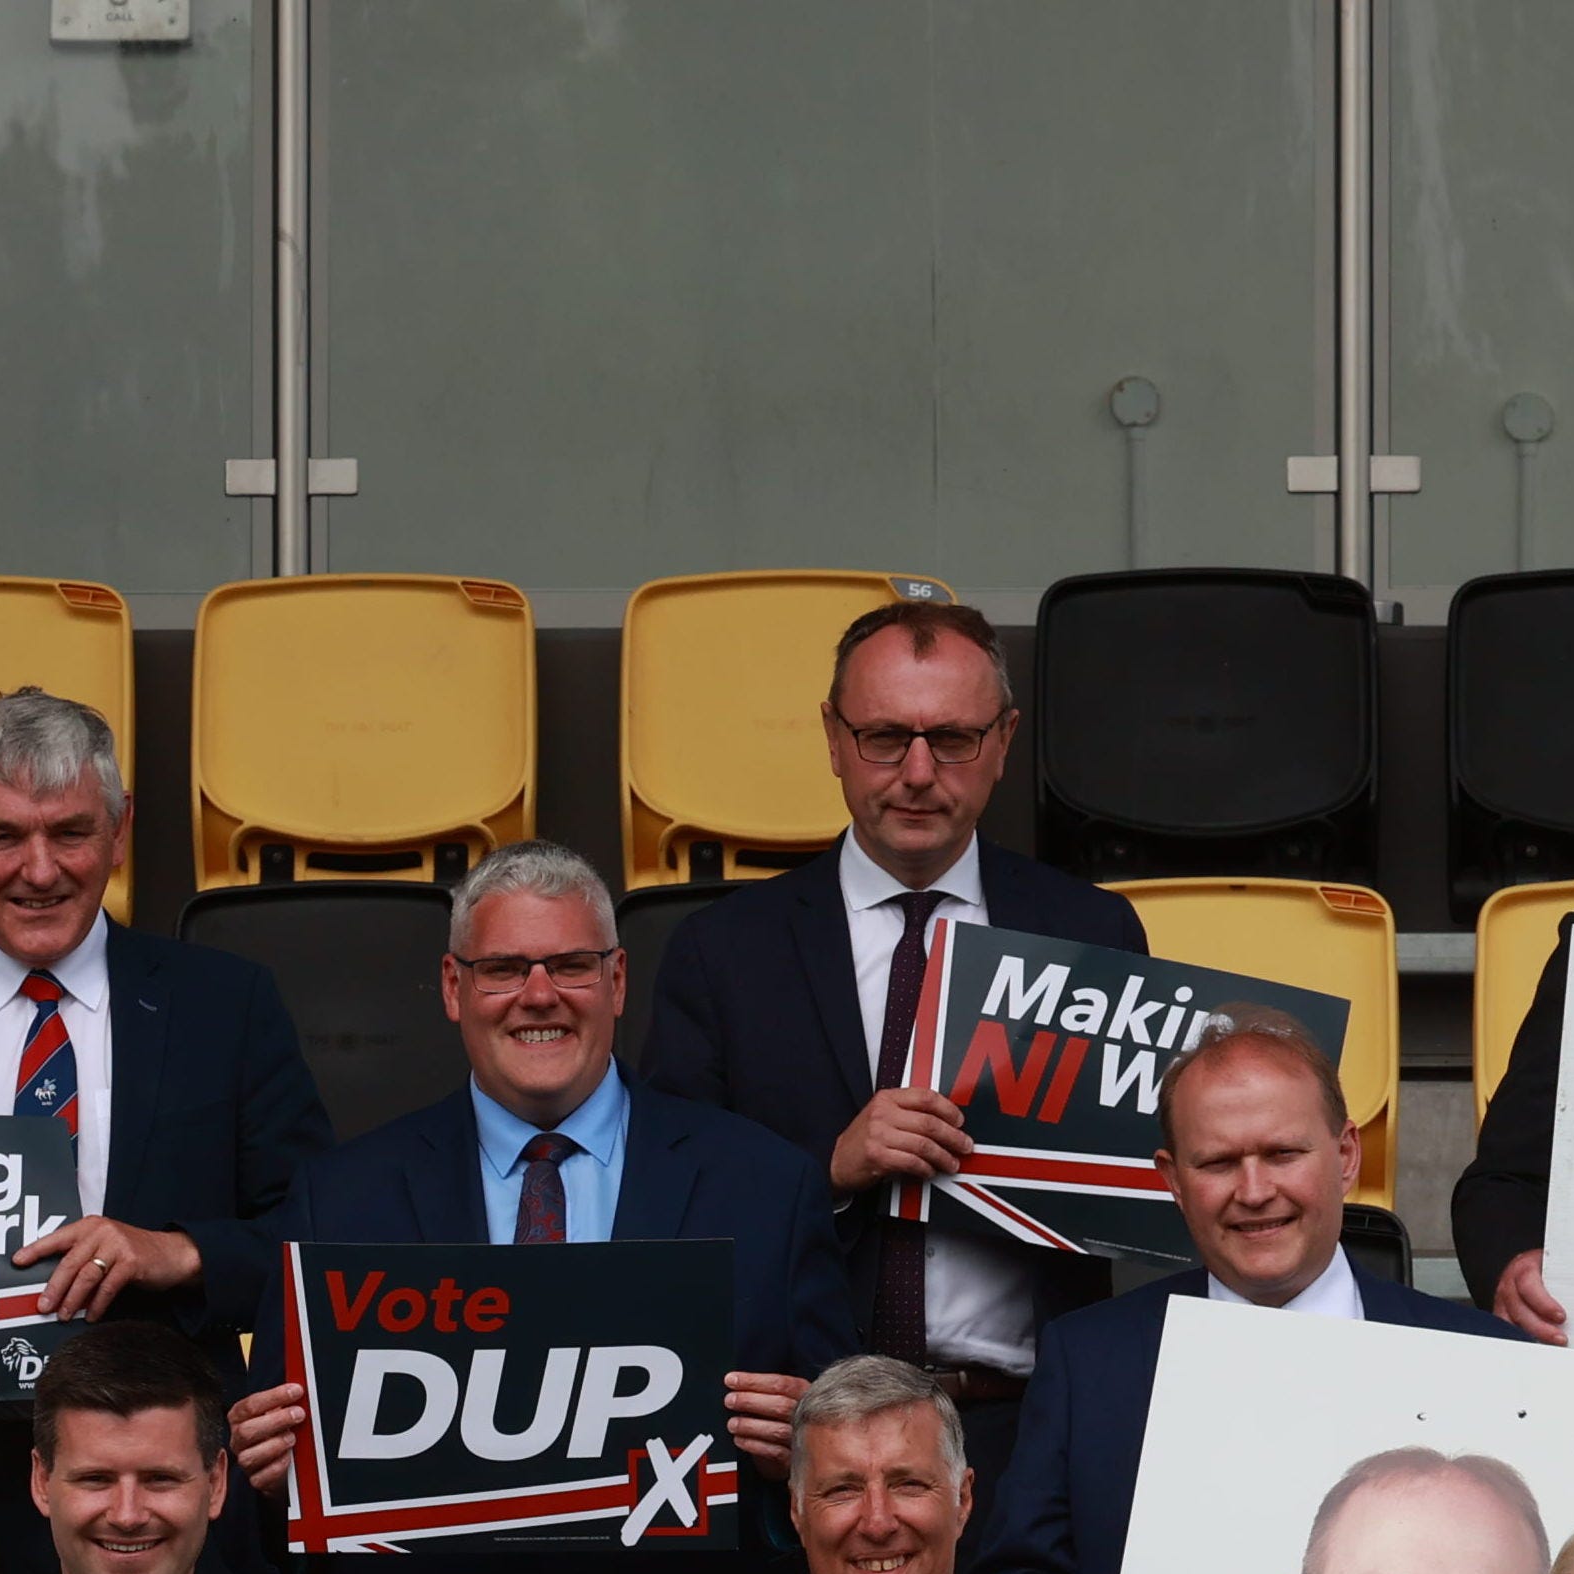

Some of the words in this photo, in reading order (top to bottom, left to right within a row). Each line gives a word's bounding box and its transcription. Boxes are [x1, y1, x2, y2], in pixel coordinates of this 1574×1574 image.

[106, 13, 135, 22] CALL
[908, 584, 932, 598] 56
[981, 954, 1234, 1052] Makin
[950, 1020, 1089, 1124] NI
[324, 1271, 511, 1334] Vote
[337, 1345, 684, 1461] DUP
